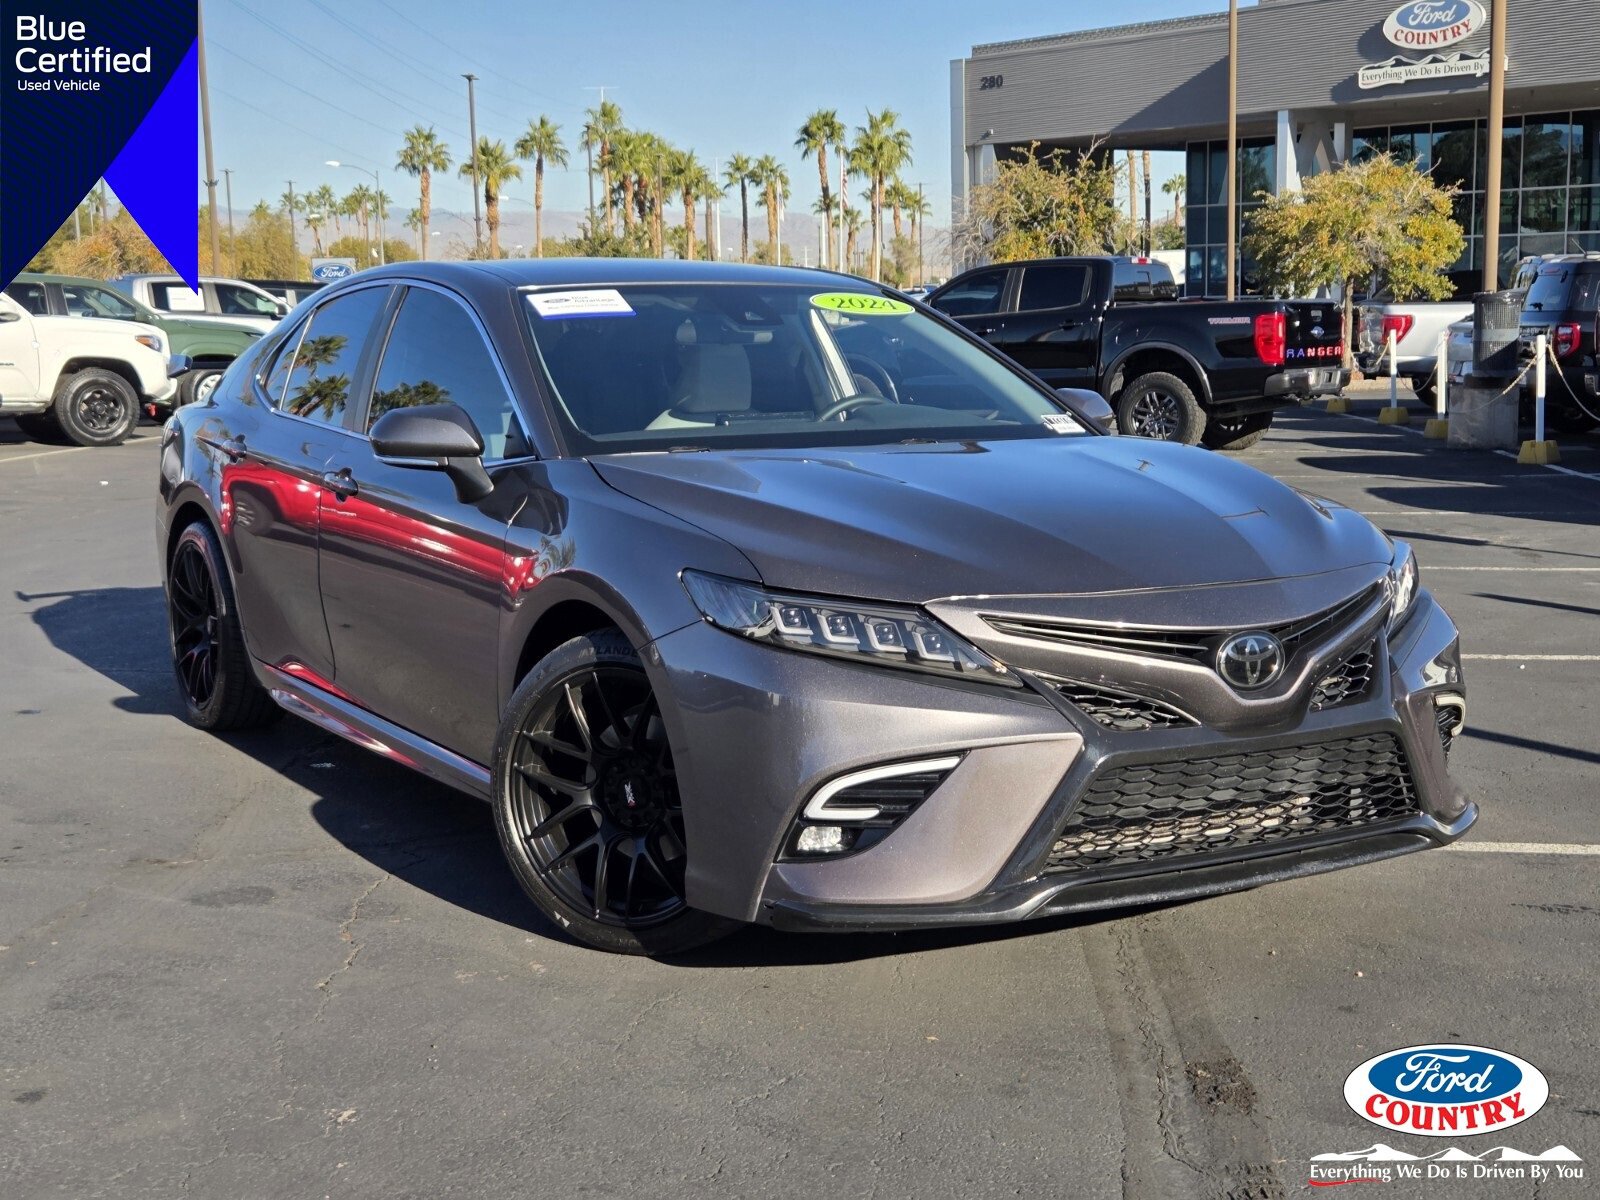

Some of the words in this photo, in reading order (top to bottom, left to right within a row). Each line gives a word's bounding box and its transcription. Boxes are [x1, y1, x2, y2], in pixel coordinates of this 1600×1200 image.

[1408, 0, 1457, 26] Ford
[1394, 19, 1472, 45] COUNTRY
[1361, 68, 1402, 82] Everything
[1405, 68, 1418, 77] We
[1420, 66, 1432, 76] Do
[1434, 66, 1441, 75] Is
[1443, 64, 1471, 74] Driven
[1474, 62, 1484, 73] By
[980, 75, 1003, 90] 280
[321, 266, 346, 278] Ford
[1286, 346, 1342, 358] RANGER
